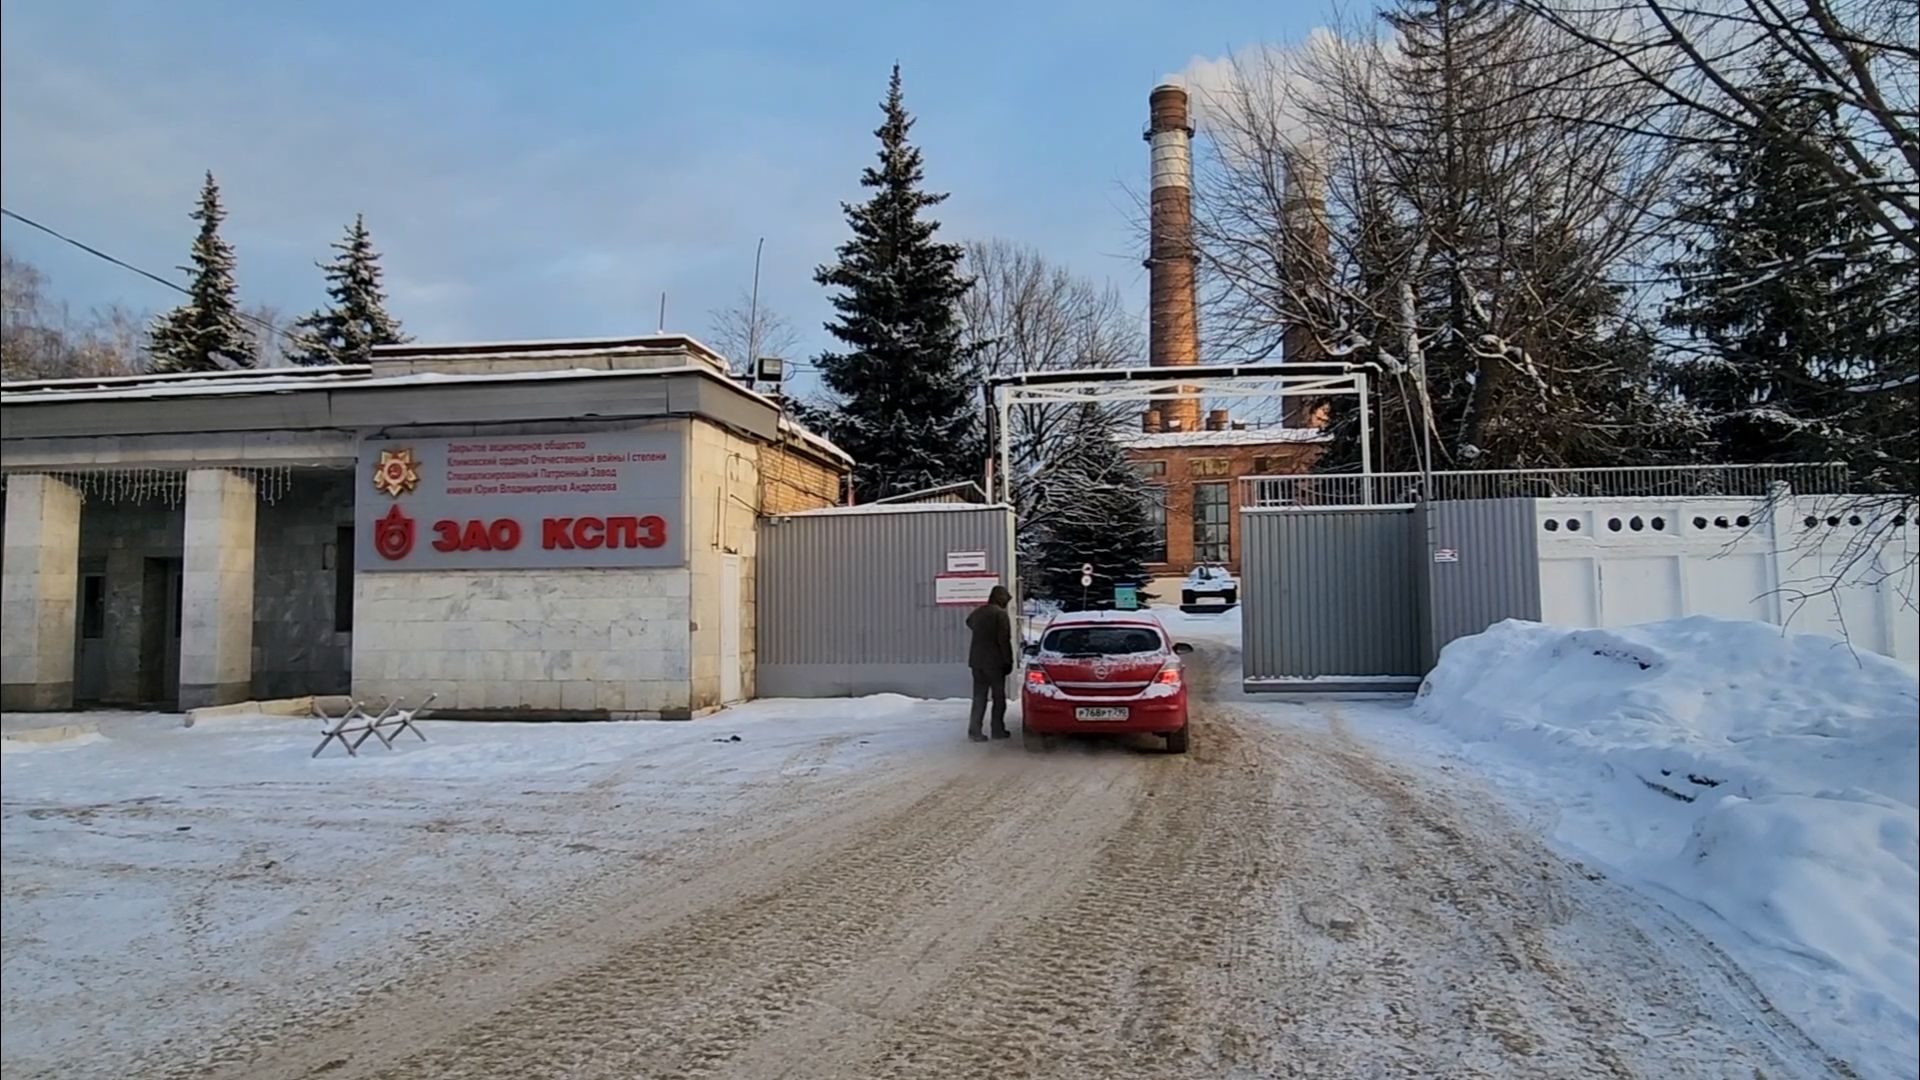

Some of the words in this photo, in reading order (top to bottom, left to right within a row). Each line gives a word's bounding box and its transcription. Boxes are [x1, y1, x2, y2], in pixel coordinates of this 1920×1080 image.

[448, 443, 487, 454] Закрытое
[488, 443, 542, 452] акционерное
[544, 440, 585, 450] общество
[448, 456, 497, 466] Климовский
[499, 457, 529, 467] ордена
[531, 453, 594, 464] Отечественной
[597, 452, 625, 462] войны
[632, 453, 667, 463] степени
[447, 469, 538, 481] Специализированный
[541, 468, 588, 480] Патронный
[590, 467, 617, 477] Завод
[475, 484, 498, 496] Юрия
[500, 483, 567, 495] Владимировича
[569, 483, 617, 493] Андропова
[432, 519, 521, 552] ЗАО
[542, 515, 667, 550] КСПЗ
